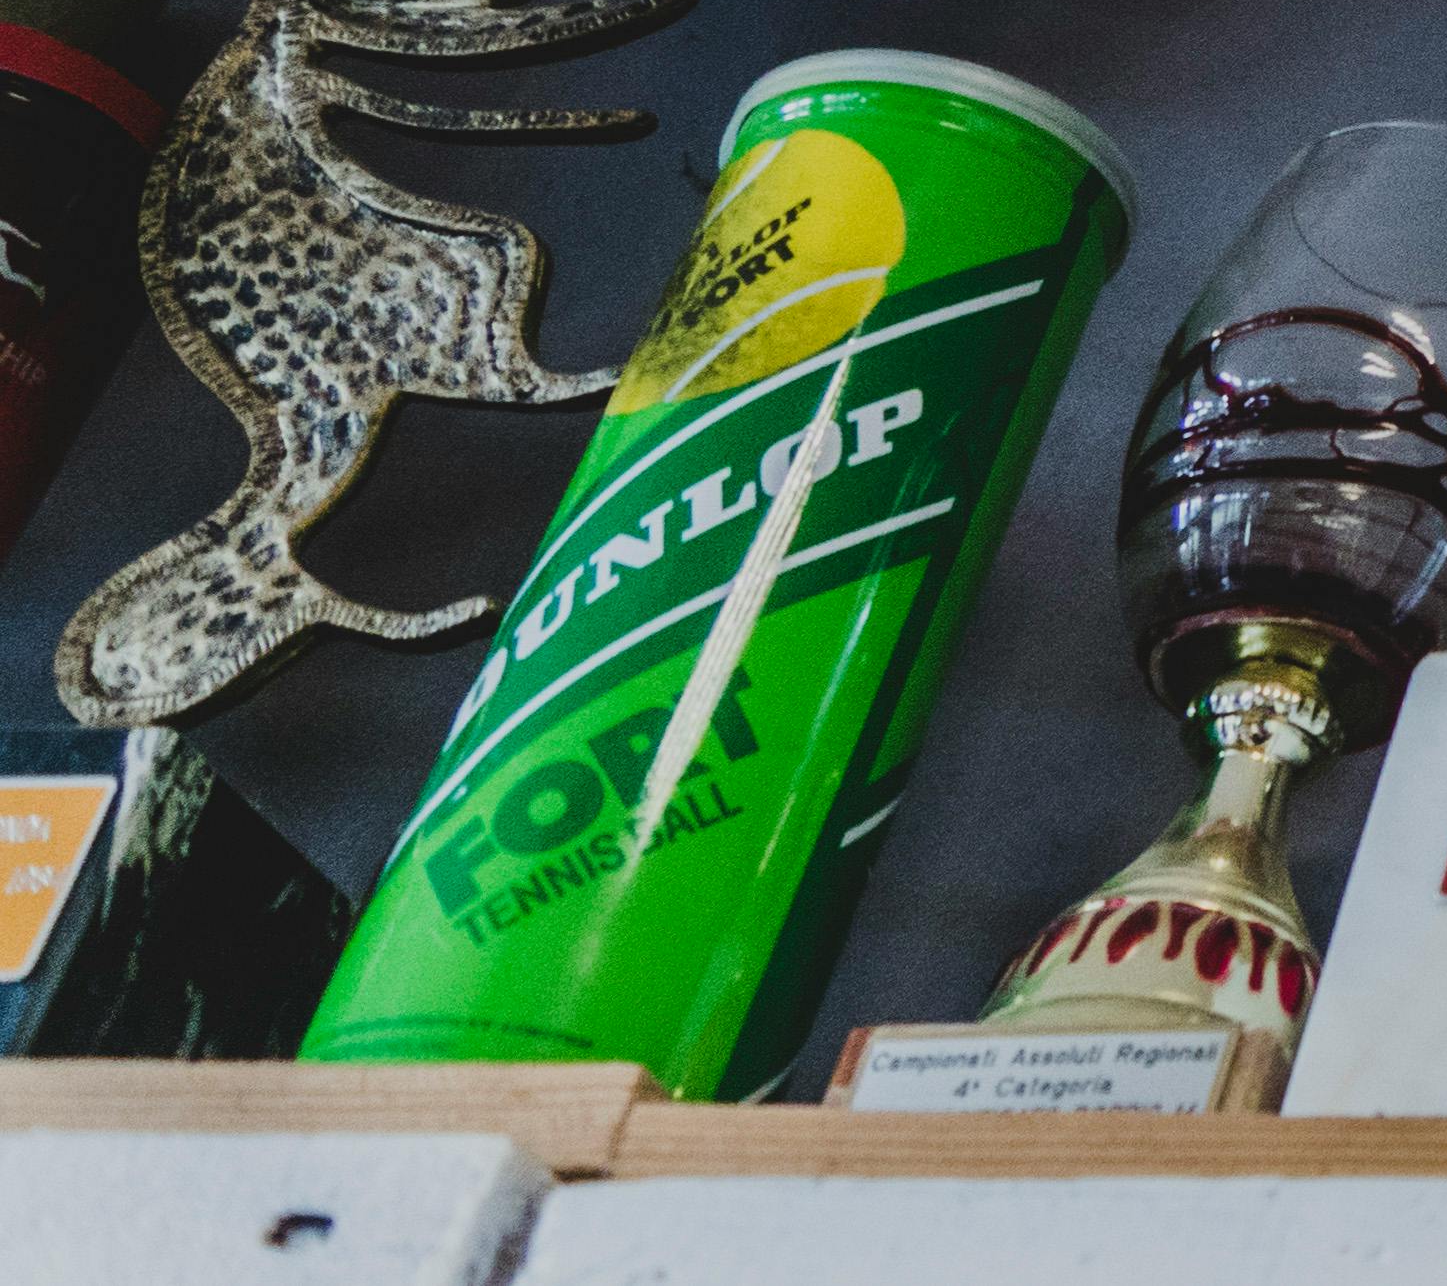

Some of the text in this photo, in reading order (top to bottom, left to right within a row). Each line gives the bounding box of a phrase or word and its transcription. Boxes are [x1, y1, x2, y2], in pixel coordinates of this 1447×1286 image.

[446, 387, 923, 753] DUNLOP
[423, 663, 764, 919] FORT
[448, 830, 627, 945] TENNIS
[870, 1040, 1221, 1074] Campionati Assoluti Regionali
[994, 1075, 1114, 1100] Categoria
